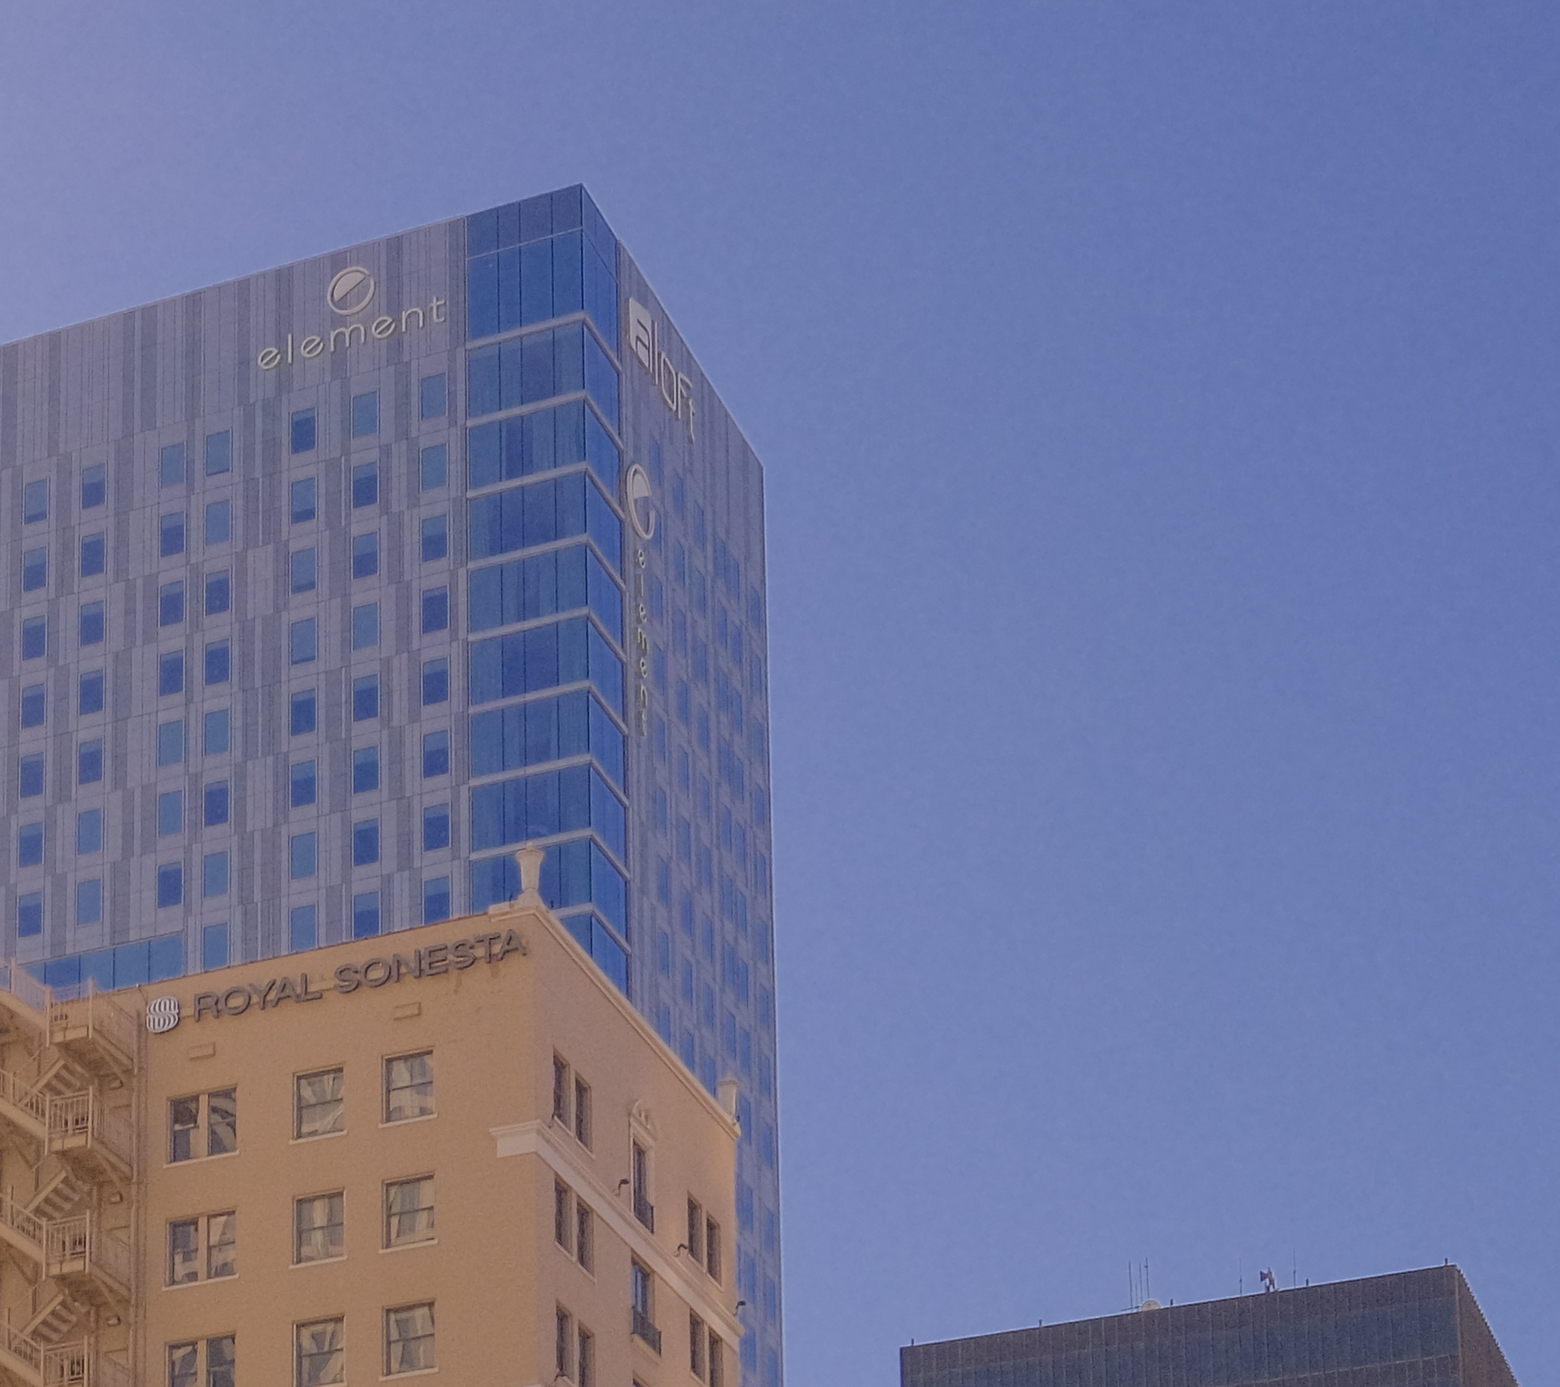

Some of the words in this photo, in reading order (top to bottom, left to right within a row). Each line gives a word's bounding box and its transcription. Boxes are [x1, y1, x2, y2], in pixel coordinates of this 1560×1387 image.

[258, 296, 445, 370] element
[628, 298, 695, 444] aloft
[193, 972, 323, 1022] ROYAL
[334, 929, 528, 993] SONESTA
